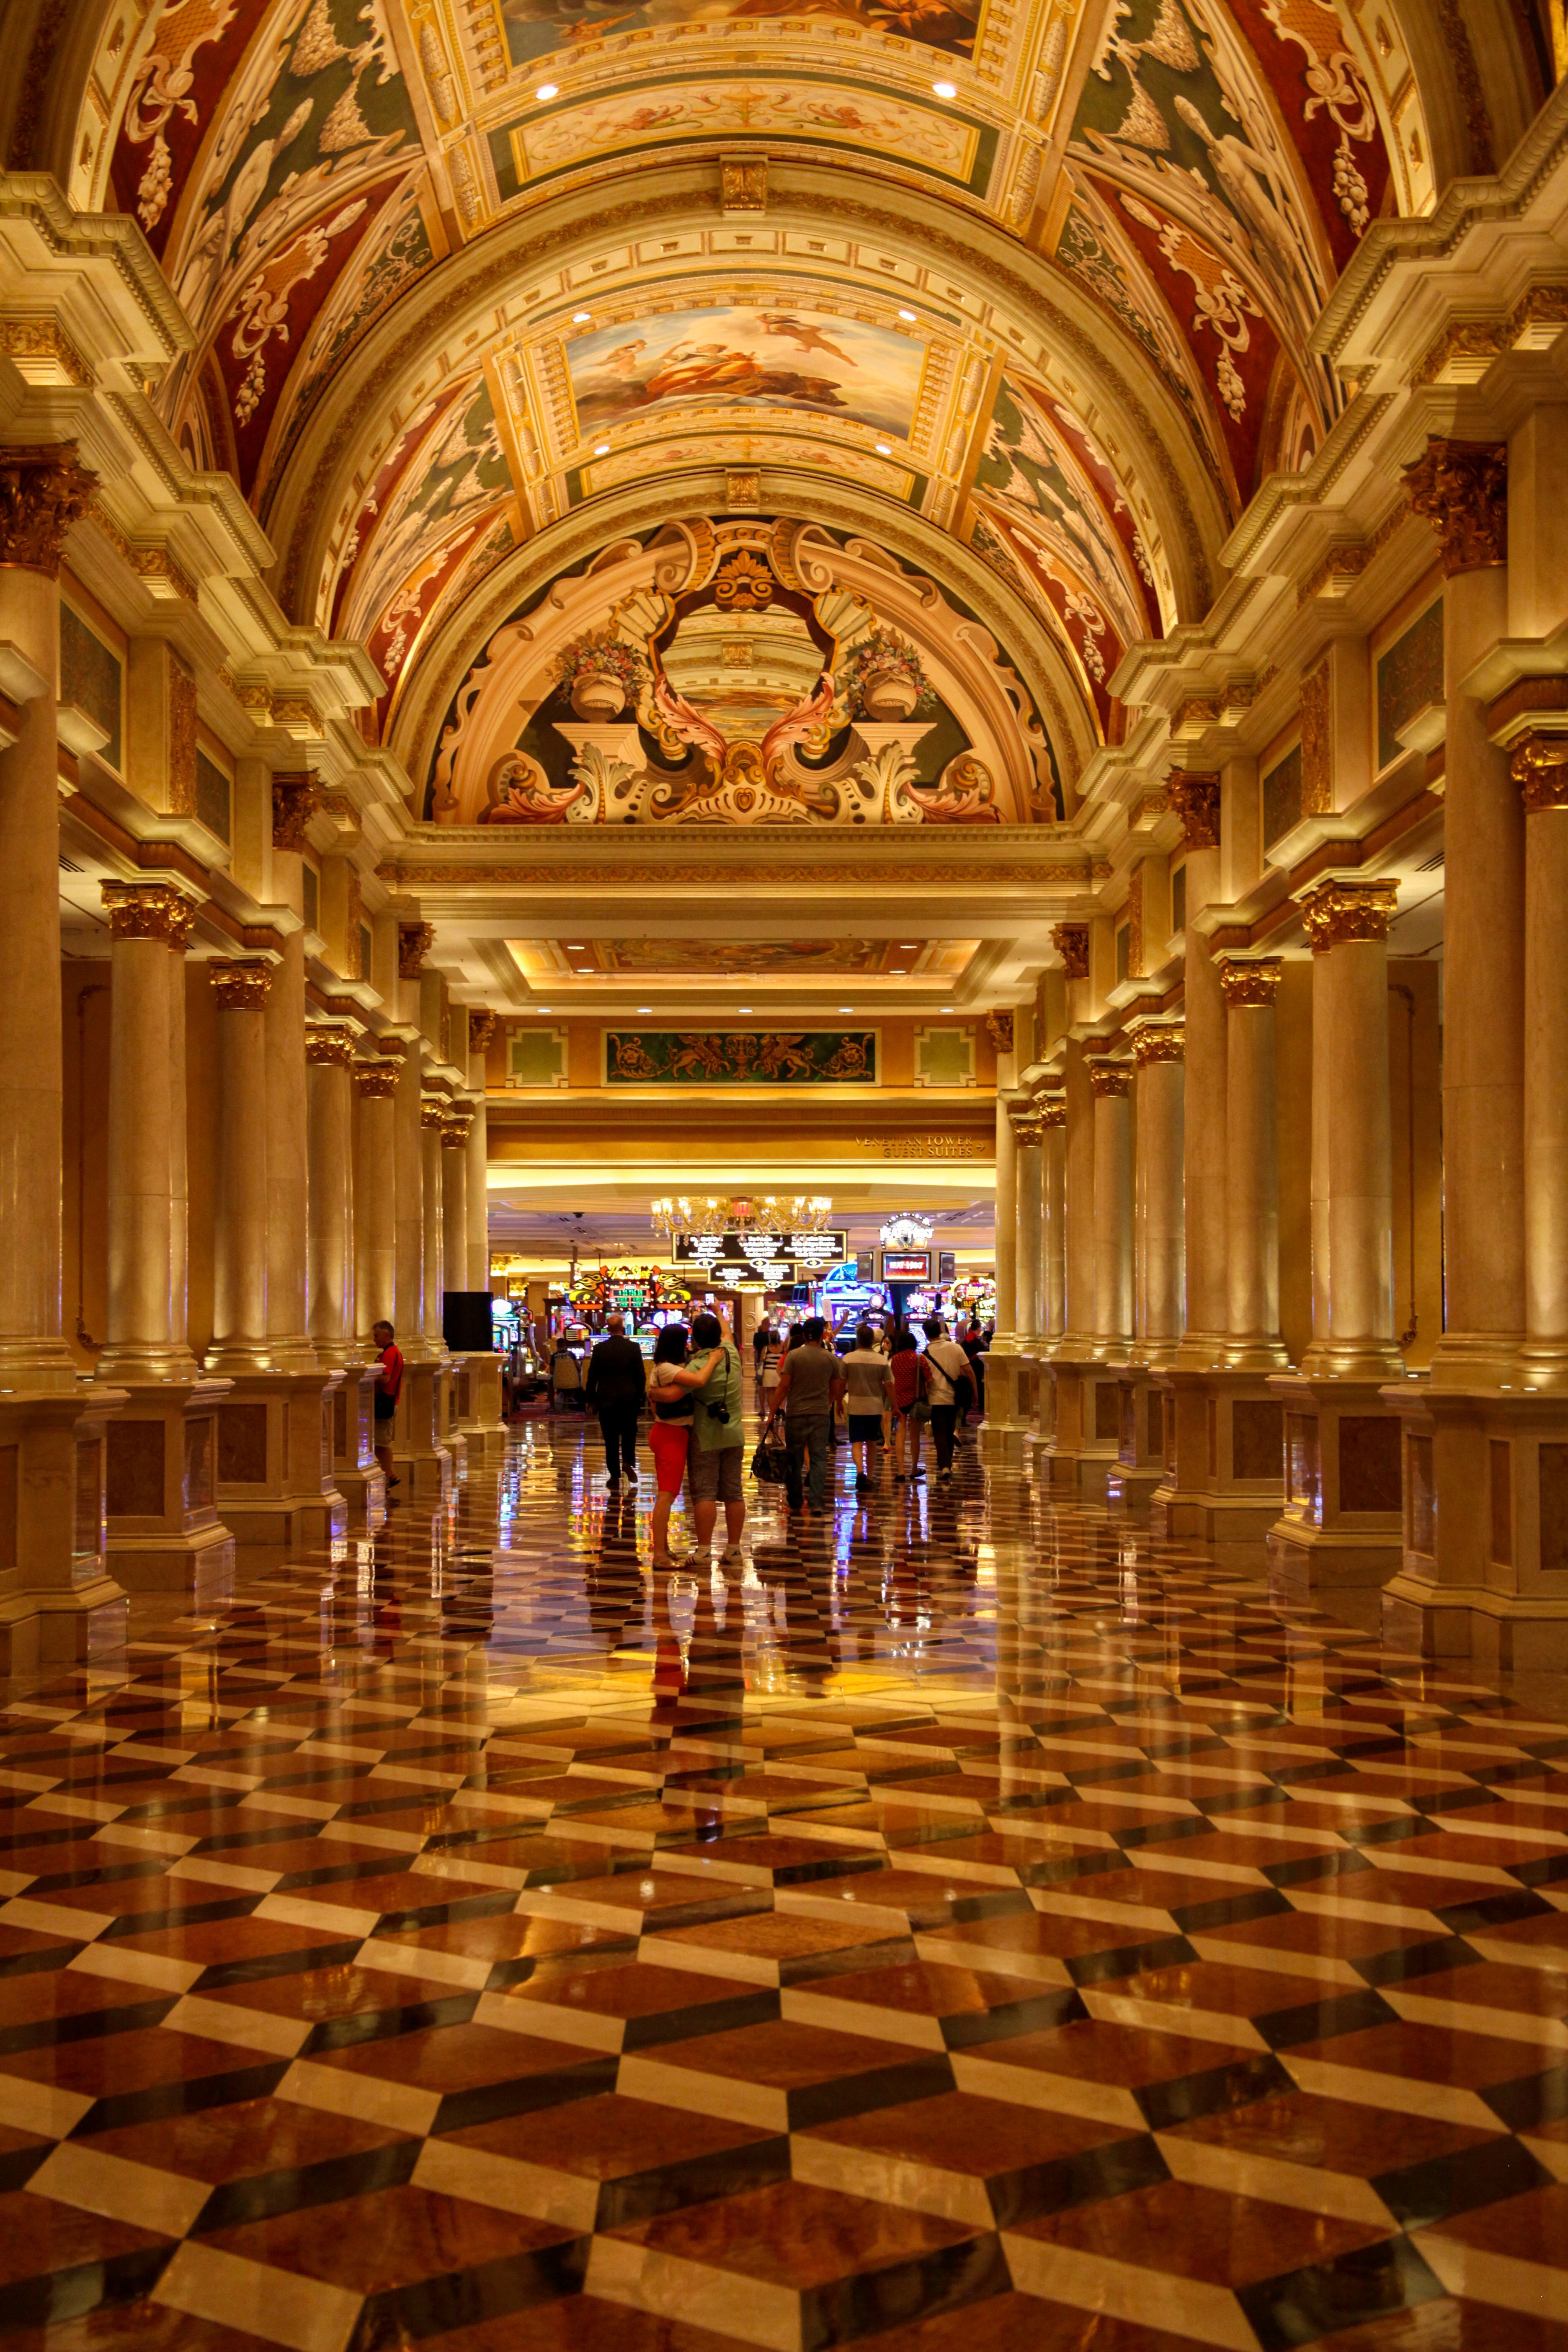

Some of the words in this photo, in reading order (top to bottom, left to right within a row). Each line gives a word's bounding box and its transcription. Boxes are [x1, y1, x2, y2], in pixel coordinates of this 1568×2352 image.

[855, 1136, 921, 1146] VENETIAN
[926, 1136, 972, 1146] TOWER
[884, 1148, 924, 1157] GUEST
[928, 1148, 972, 1157] SUITES
